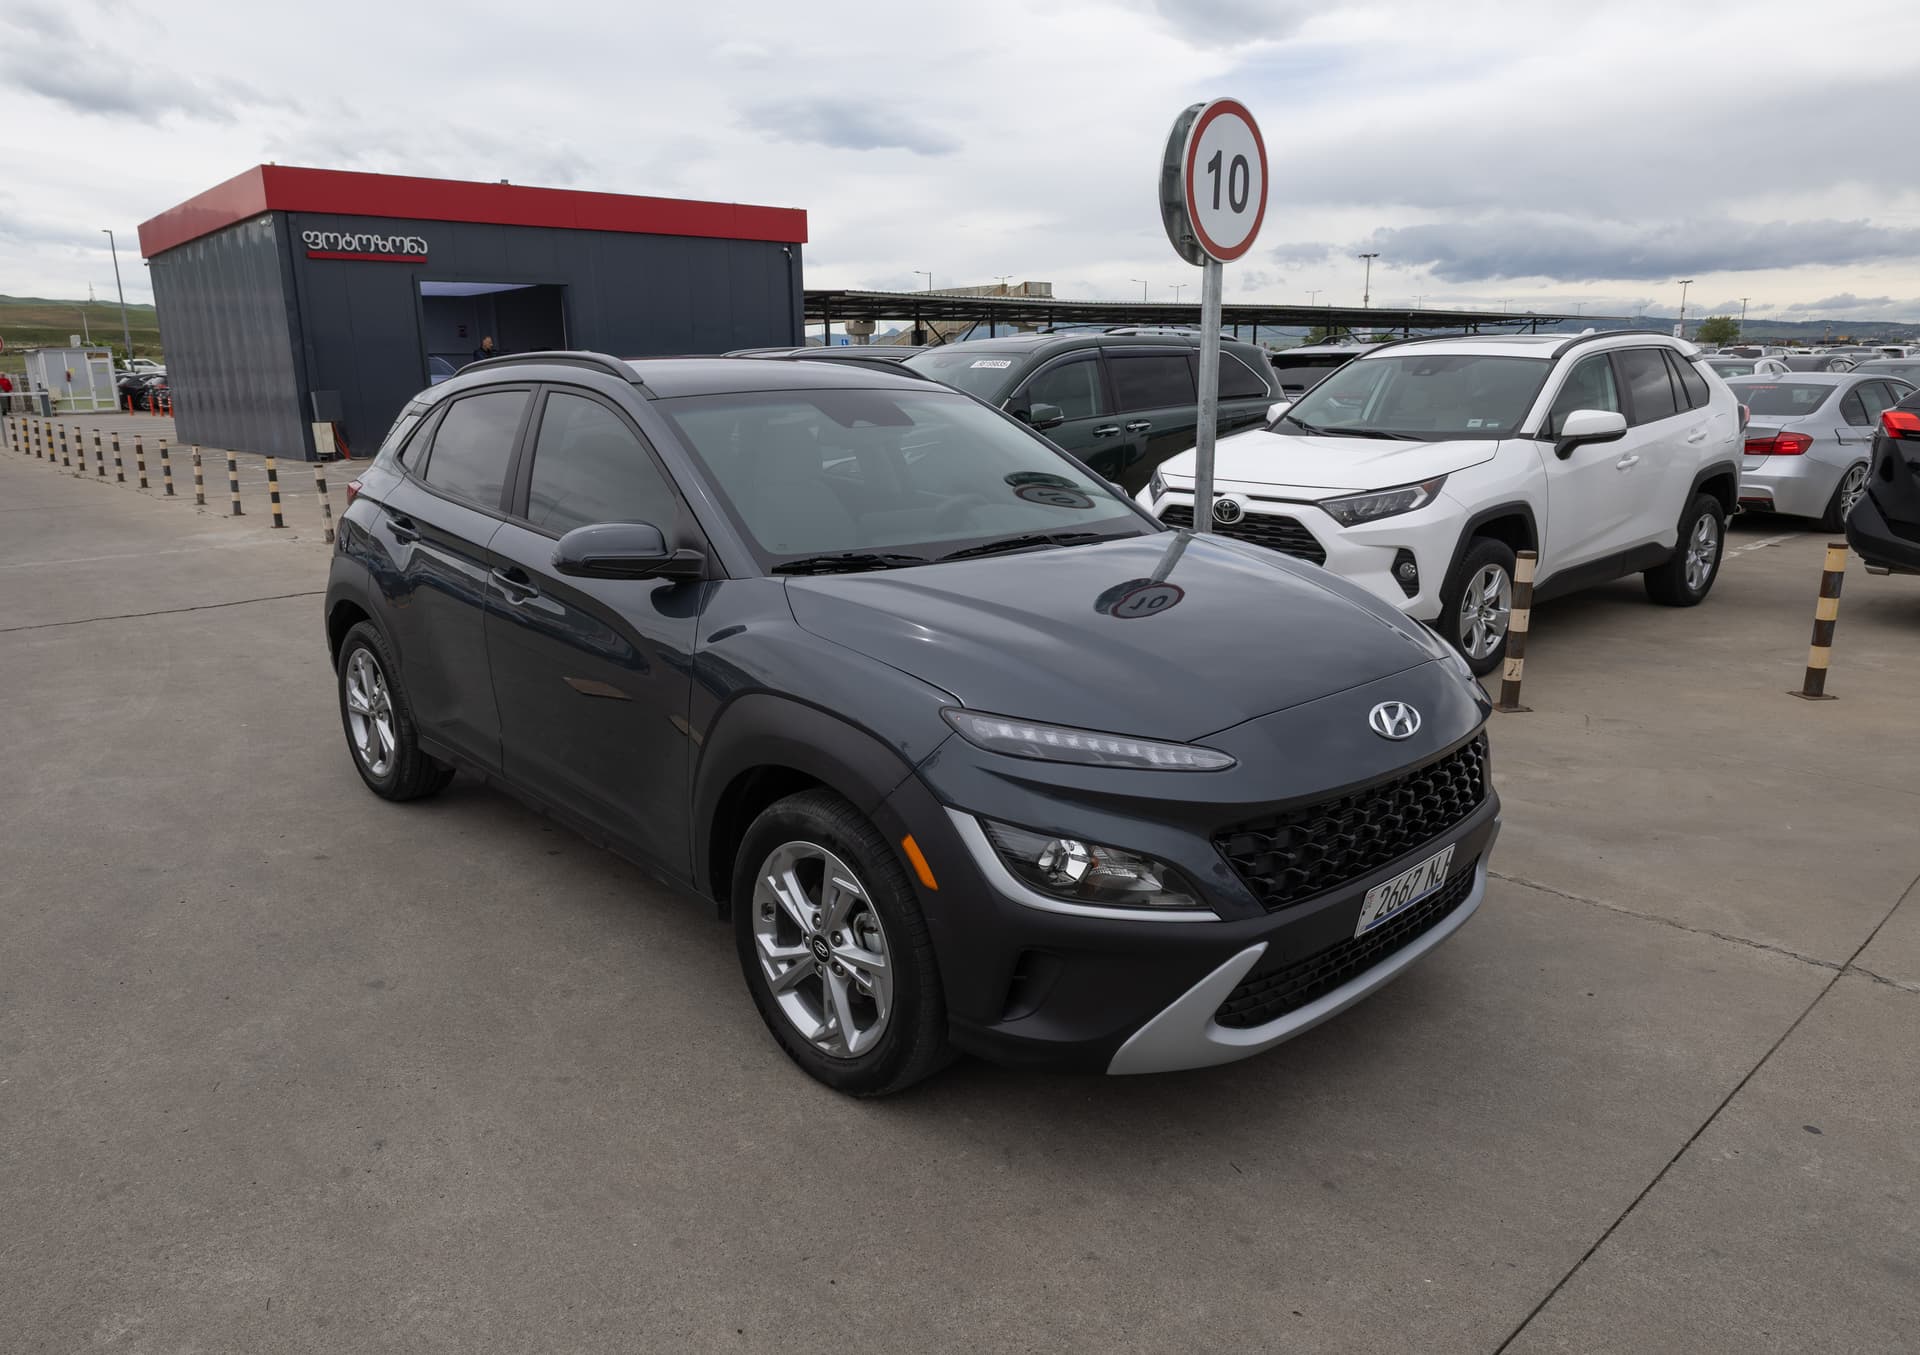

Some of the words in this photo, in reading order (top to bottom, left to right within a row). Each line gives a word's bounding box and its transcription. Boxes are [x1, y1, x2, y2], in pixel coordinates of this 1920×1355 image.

[1208, 150, 1249, 214] 10
[302, 231, 428, 254] ფოტოზონა
[1374, 866, 1424, 919] 2667
[1424, 851, 1452, 890] NJ
